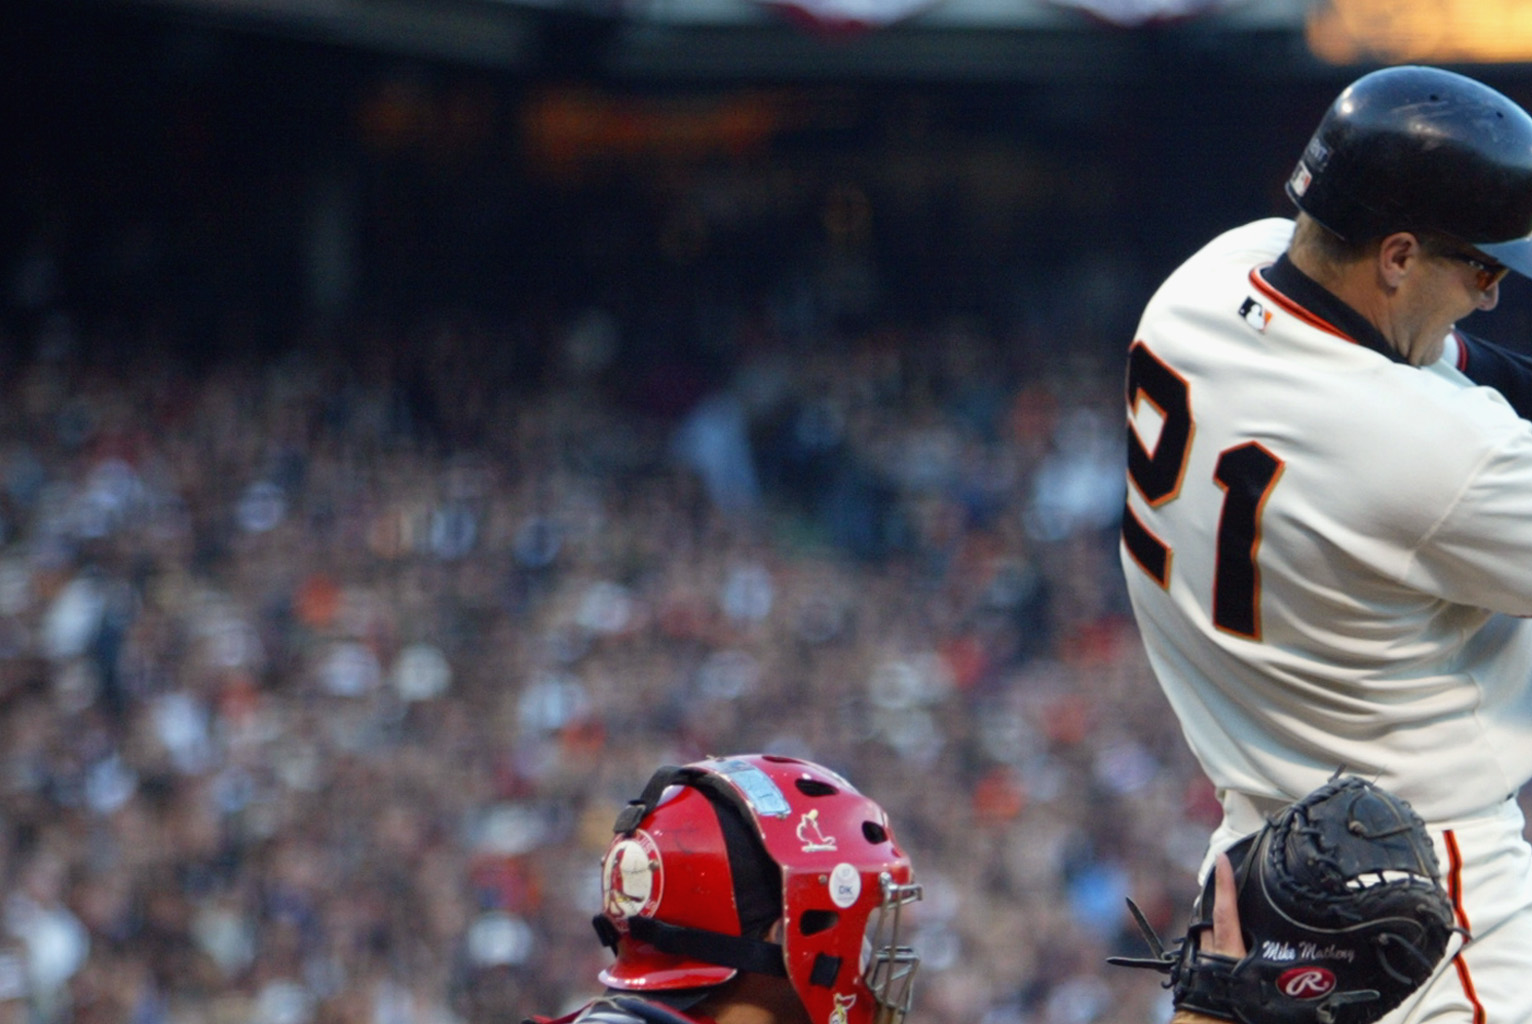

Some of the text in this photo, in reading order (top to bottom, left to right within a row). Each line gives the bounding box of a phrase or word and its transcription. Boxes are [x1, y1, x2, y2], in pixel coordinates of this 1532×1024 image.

[1121, 340, 1286, 641] 21
[1262, 940, 1297, 960] Mike
[1285, 971, 1328, 995] R
